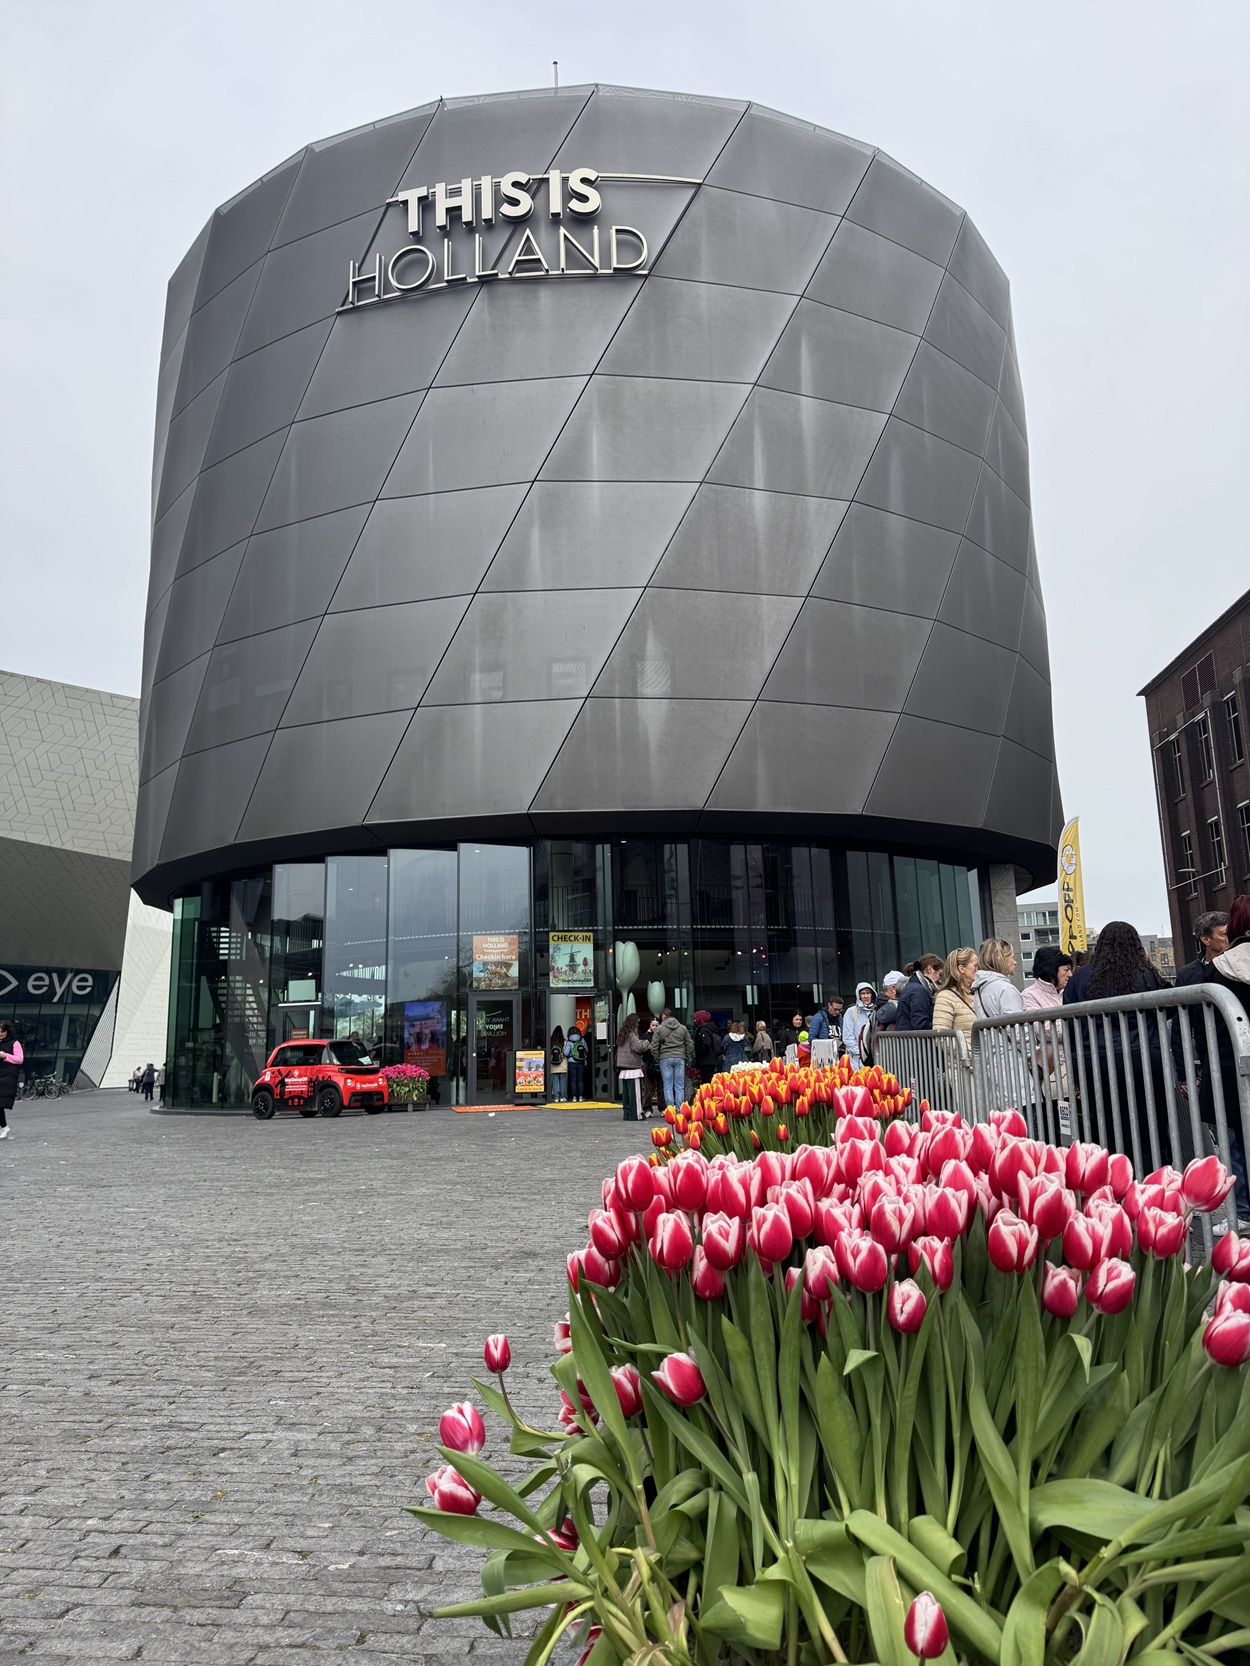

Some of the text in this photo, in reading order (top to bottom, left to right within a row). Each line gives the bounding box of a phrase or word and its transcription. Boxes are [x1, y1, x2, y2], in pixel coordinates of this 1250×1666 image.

[398, 168, 602, 238] THIS IS
[350, 225, 648, 305] HOLLAND
[551, 934, 592, 943] CHECK-IN
[27, 972, 94, 1003] eye
